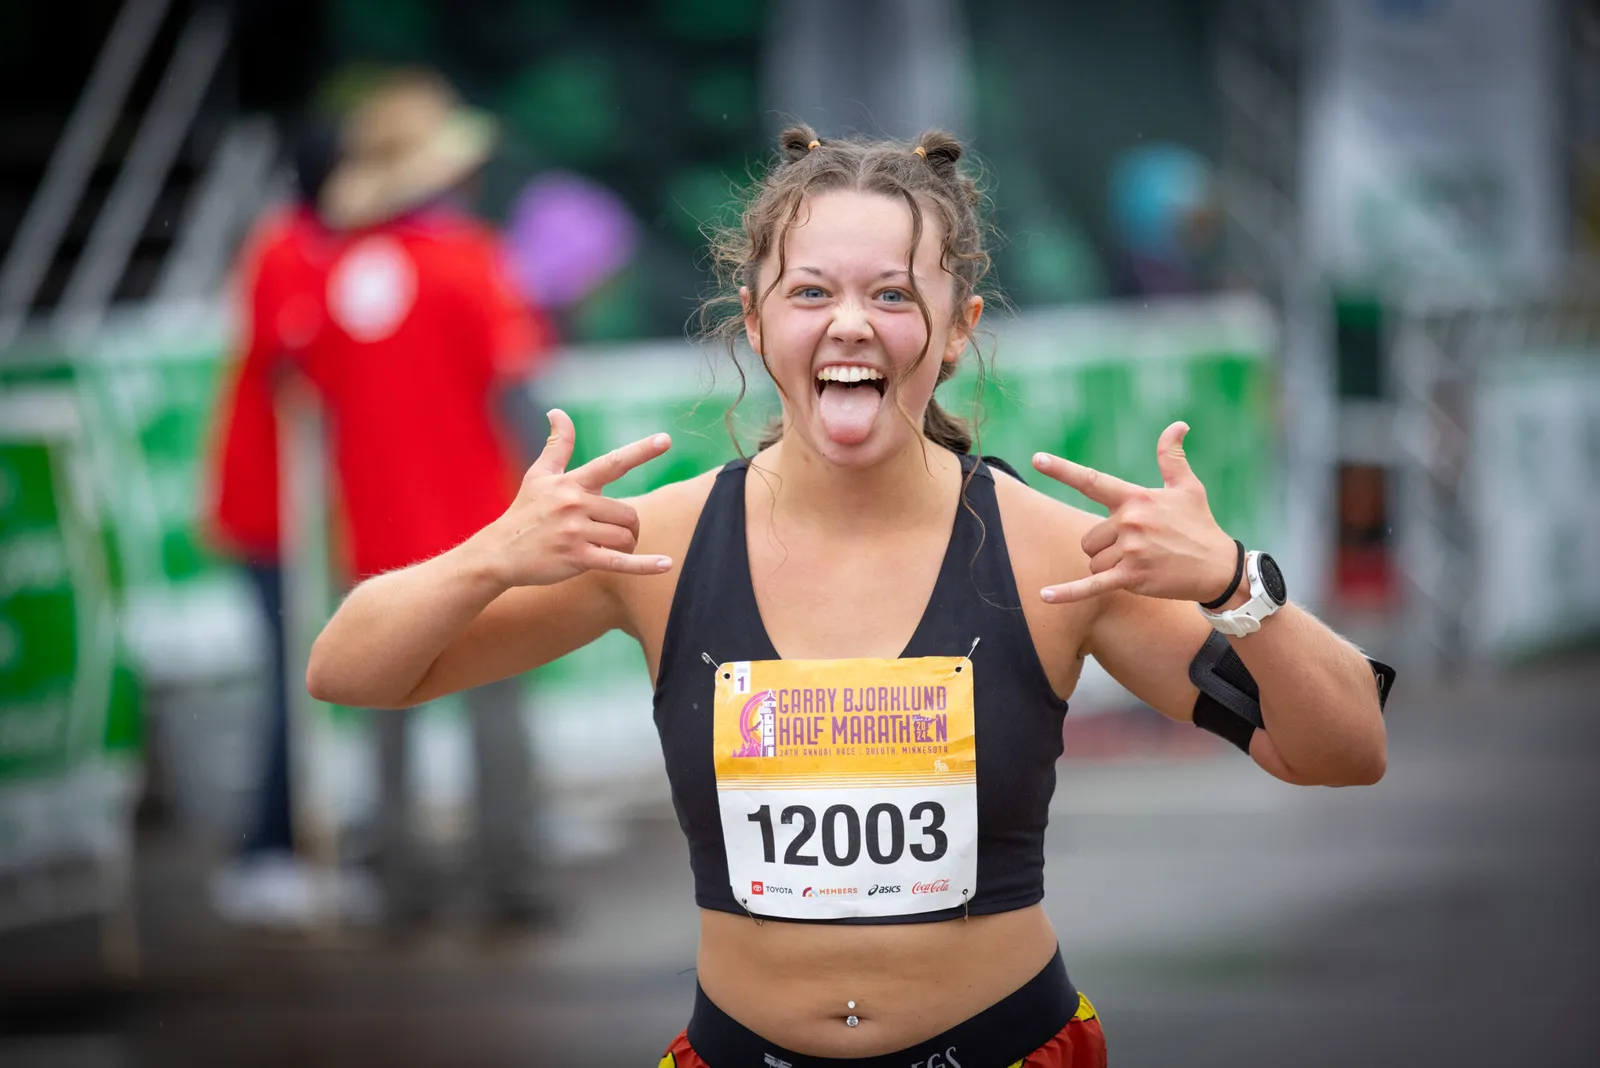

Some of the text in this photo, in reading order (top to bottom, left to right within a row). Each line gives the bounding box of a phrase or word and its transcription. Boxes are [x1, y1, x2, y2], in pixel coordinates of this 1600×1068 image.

[737, 676, 745, 691] 1
[779, 686, 946, 714] GARRY BJORKLUND
[779, 716, 824, 746] HALF
[803, 748, 832, 756] ANNUAL
[836, 747, 856, 756] RACE
[902, 746, 948, 755] MINNESOTA
[747, 801, 948, 867] 12003
[765, 885, 793, 895] TOYOTA
[819, 887, 858, 895] MEMBERS
[911, 1046, 961, 1068] GS
